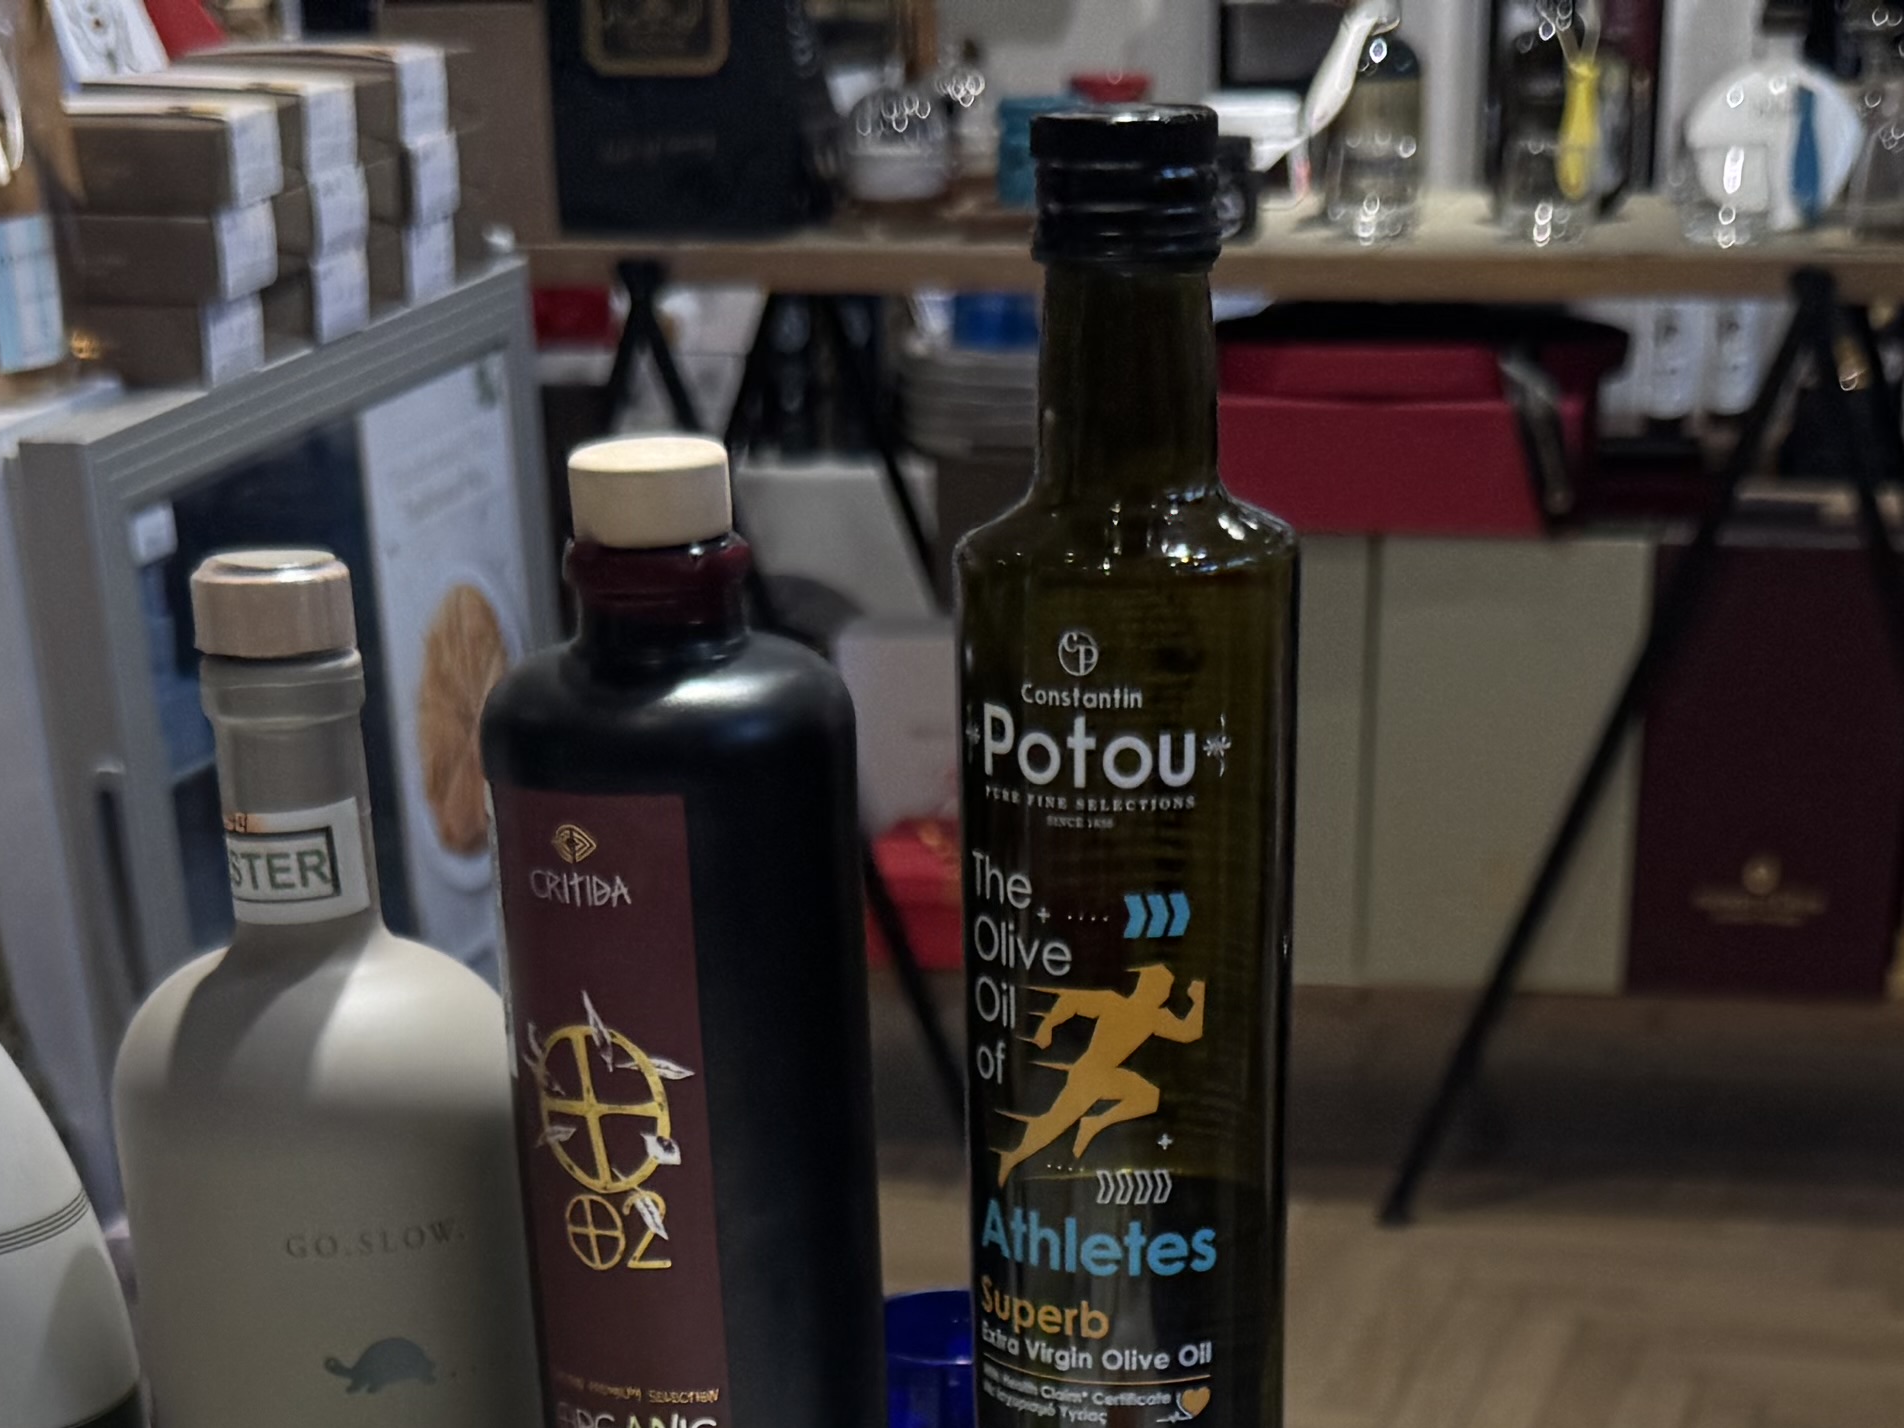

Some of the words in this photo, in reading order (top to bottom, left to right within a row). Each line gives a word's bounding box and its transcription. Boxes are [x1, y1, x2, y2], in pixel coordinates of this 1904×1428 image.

[1020, 682, 1144, 709] Constantin
[983, 702, 1197, 789] Potou
[1026, 793, 1068, 811] FINE
[1074, 795, 1196, 813] SELECTIONS
[530, 869, 633, 908] CRITIDA
[971, 850, 1033, 909] The
[973, 915, 1073, 977] Olive
[974, 975, 1016, 1030] Oil
[976, 1040, 1007, 1085] of
[981, 1199, 1218, 1277] Athletes
[981, 1274, 1110, 1340] Superb
[981, 1320, 1019, 1356] Extra
[1024, 1336, 1093, 1372] Virgin
[1101, 1347, 1171, 1371] Olive
[1177, 1340, 1213, 1368] Oil
[648, 1387, 721, 1404] SELECTION
[1091, 1389, 1173, 1406] Certificate
